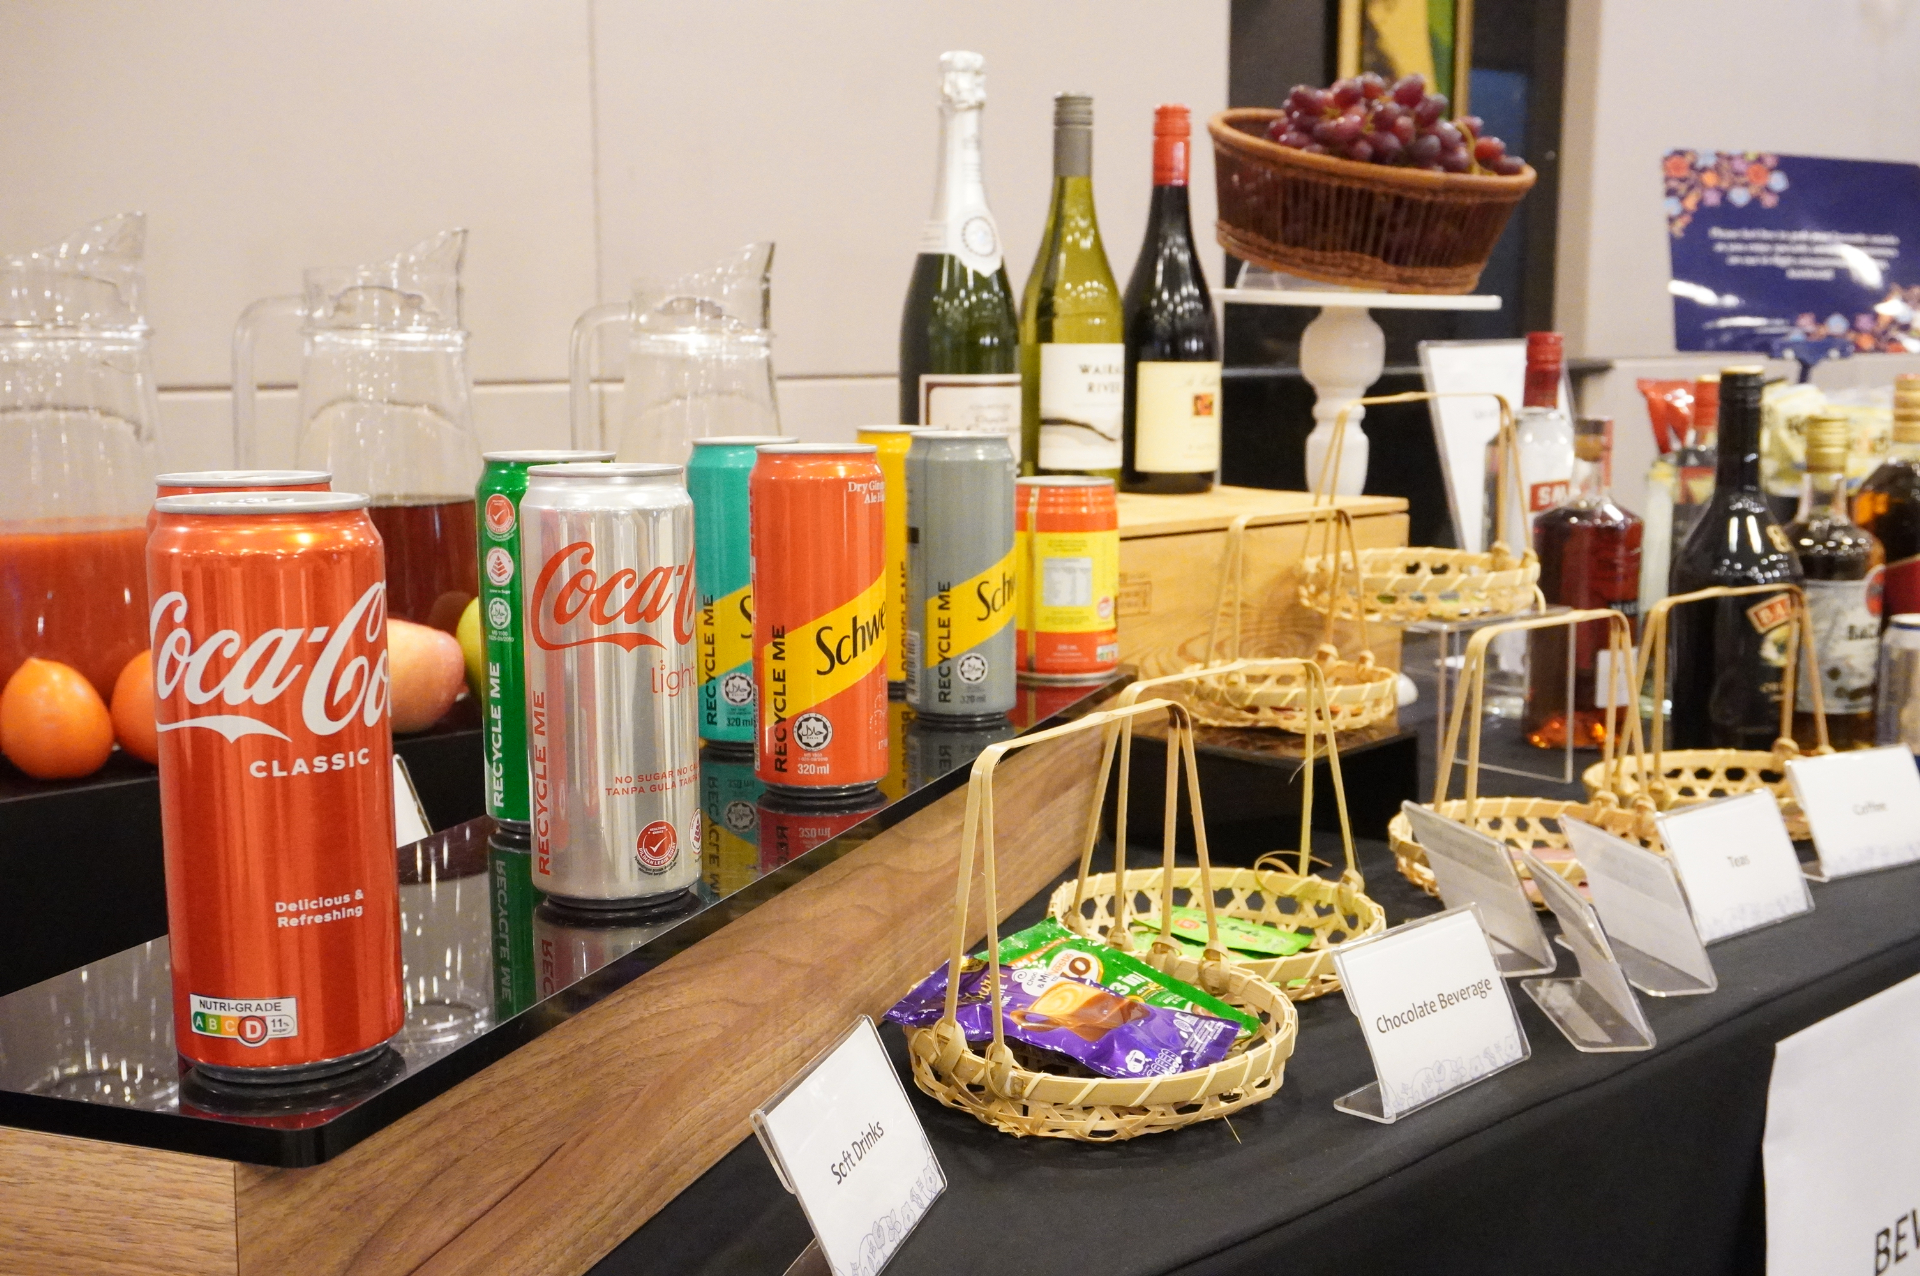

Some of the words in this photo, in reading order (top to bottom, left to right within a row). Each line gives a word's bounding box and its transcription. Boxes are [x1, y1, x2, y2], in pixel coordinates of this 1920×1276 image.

[848, 481, 868, 494] Dry
[703, 594, 714, 626] ME
[938, 581, 950, 610] ME
[772, 625, 785, 661] ME
[938, 617, 951, 703] RECYCLE
[489, 661, 501, 699] ME
[651, 659, 696, 697] light
[704, 633, 717, 726] RECYCLE
[533, 690, 546, 736] ME
[726, 717, 741, 727] 320
[772, 668, 788, 773] RECYCLE
[249, 747, 370, 779] CLASSIC
[490, 704, 504, 809] RECYCLE
[797, 763, 815, 775] 320
[816, 763, 830, 775] ml
[605, 786, 646, 796] TANPA
[649, 781, 677, 793] GULA
[615, 775, 633, 785] NO
[637, 770, 674, 783] SUGAR
[677, 766, 688, 776] NO
[534, 744, 550, 876] RECYCLE
[1727, 855, 1751, 869] Teas
[275, 893, 351, 913] Delicious
[354, 888, 364, 900] &
[277, 905, 363, 928] Refreshing
[199, 999, 282, 1012] NUTRI-GRADE
[1376, 1000, 1438, 1034] Chocolate
[1437, 978, 1493, 1010] Beverage
[195, 1016, 203, 1028] A
[208, 1018, 218, 1030] B
[224, 1020, 236, 1032] C
[245, 1020, 262, 1039] D
[830, 1150, 856, 1186] Soft
[851, 1121, 885, 1161] Drinks
